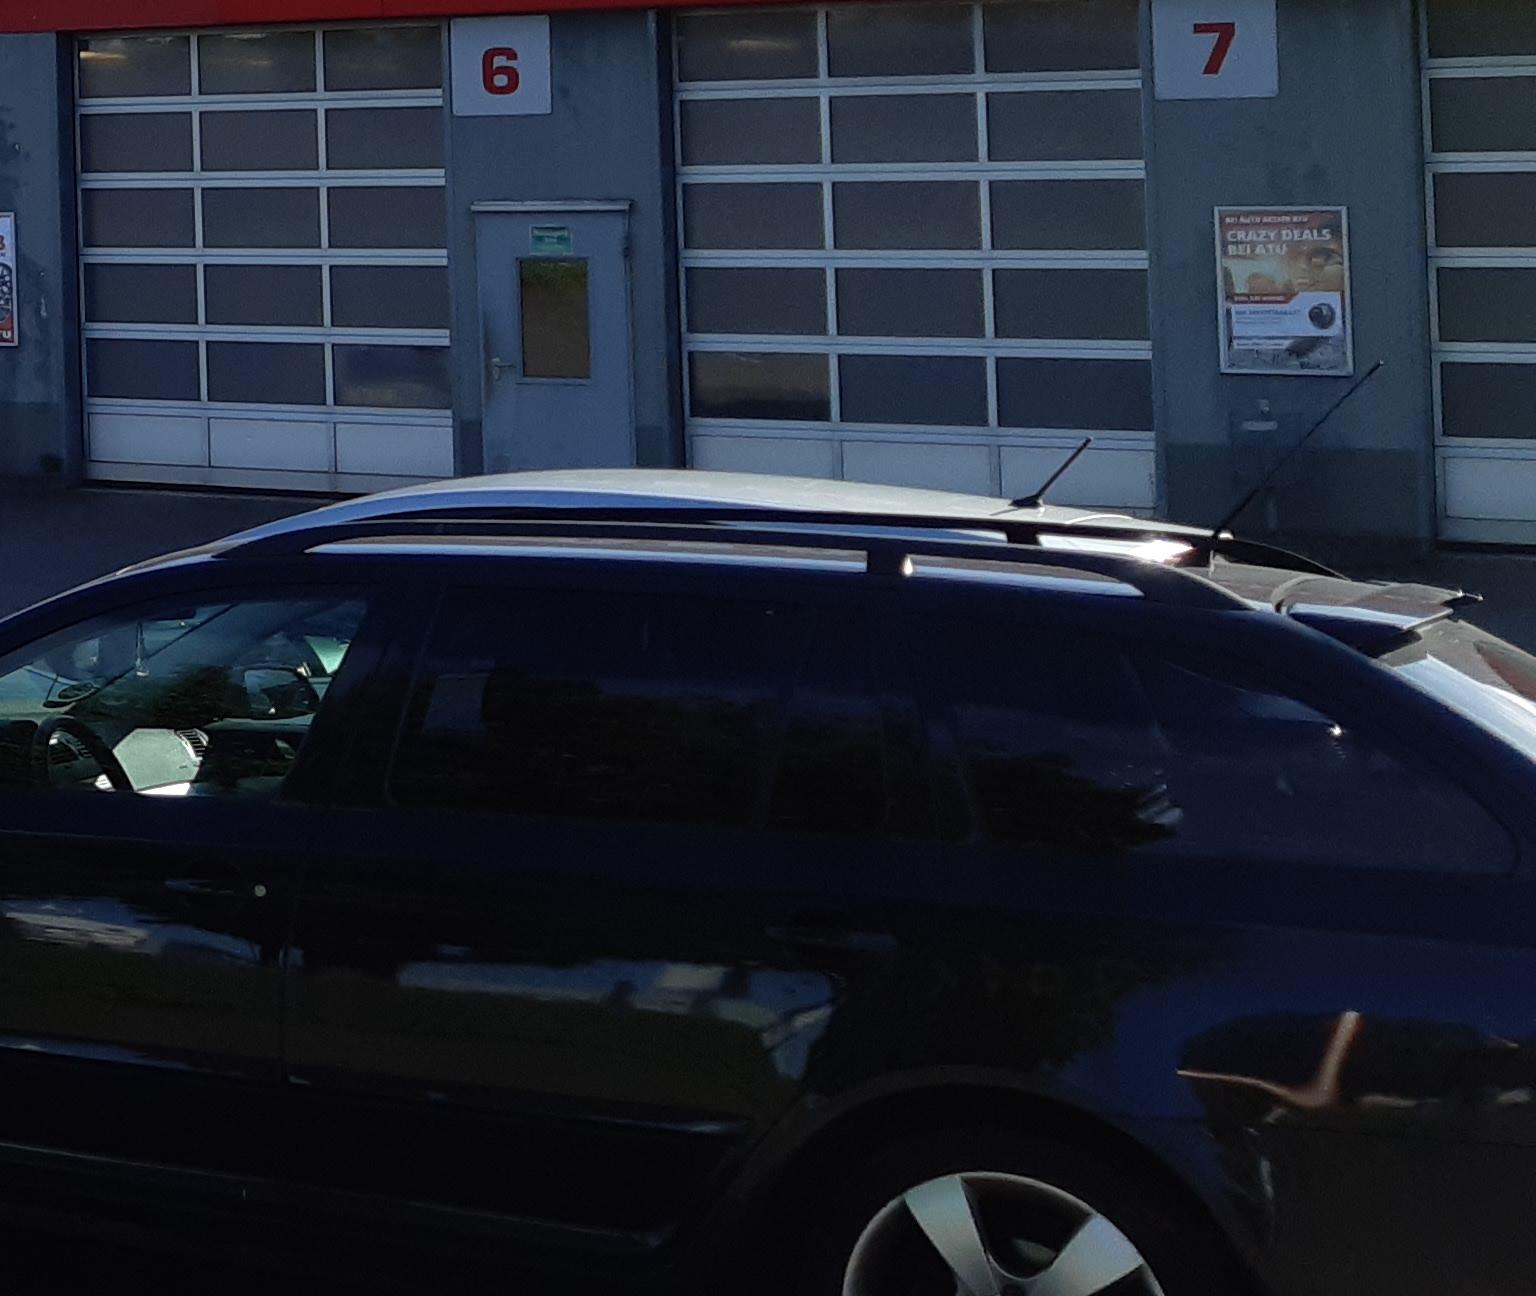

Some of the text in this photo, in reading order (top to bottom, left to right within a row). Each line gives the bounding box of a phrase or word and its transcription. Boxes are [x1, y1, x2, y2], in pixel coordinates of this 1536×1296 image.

[1193, 22, 1236, 75] 7
[482, 47, 520, 95] 6
[1227, 229, 1332, 241] CRAZY DEALS
[1228, 244, 1251, 256] BEI
